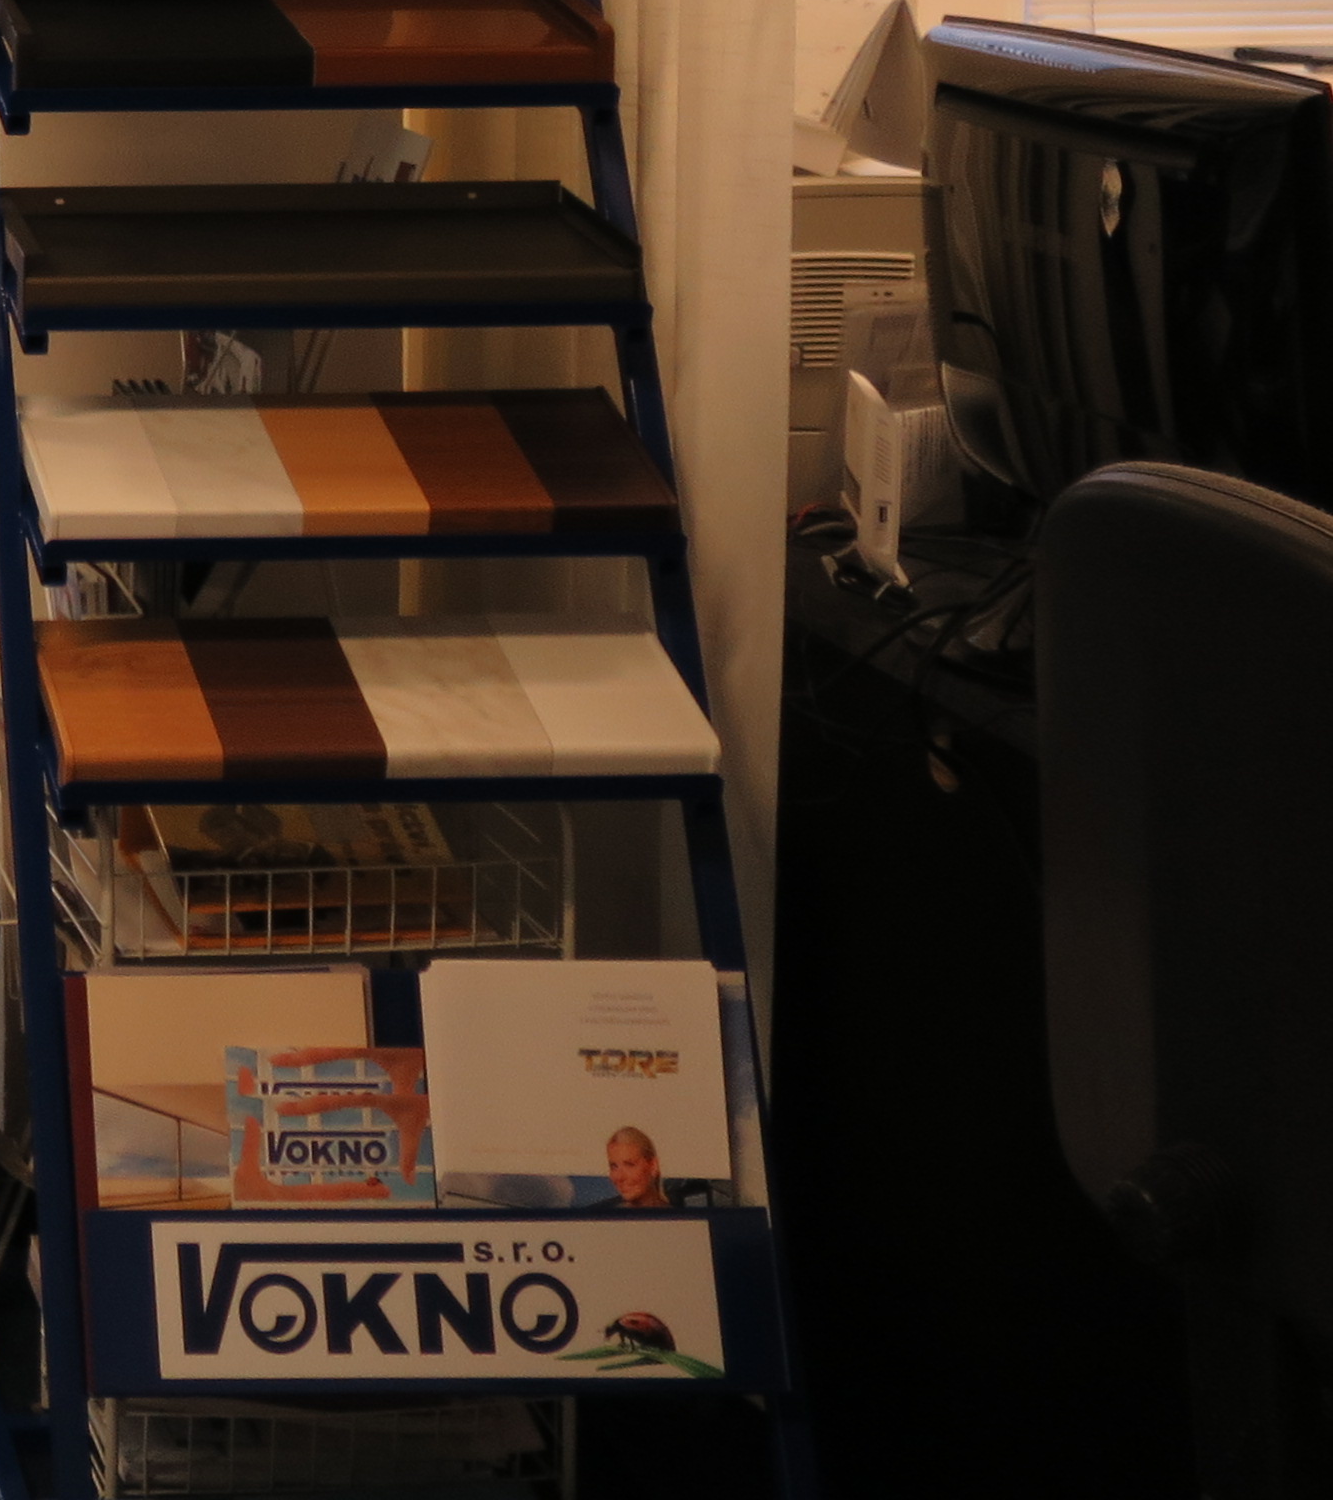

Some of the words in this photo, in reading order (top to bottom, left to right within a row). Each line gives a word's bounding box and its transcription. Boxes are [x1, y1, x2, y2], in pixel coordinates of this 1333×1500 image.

[267, 1130, 388, 1166] VOKNO
[177, 1242, 579, 1356] VOKNO
[473, 1240, 575, 1263] s.r.o.
